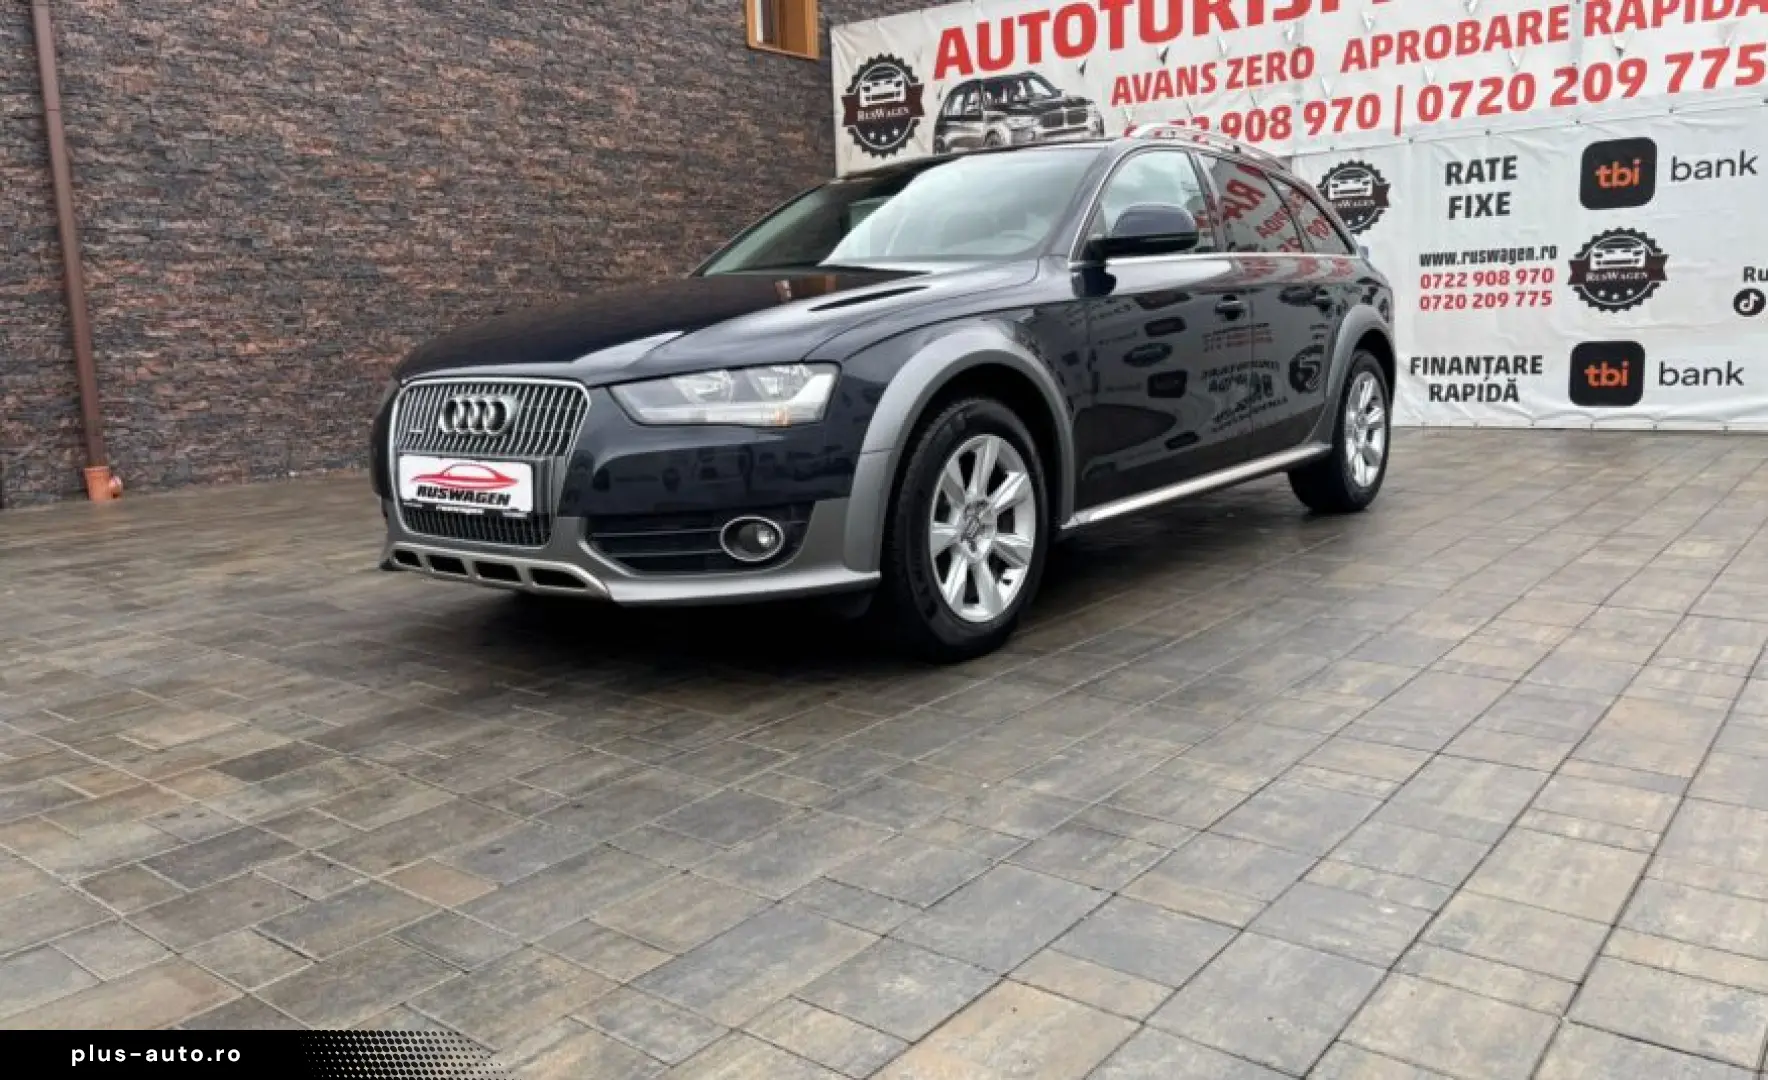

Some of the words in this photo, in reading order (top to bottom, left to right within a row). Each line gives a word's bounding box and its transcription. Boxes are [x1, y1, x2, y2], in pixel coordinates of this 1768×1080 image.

[1111, 62, 1217, 106] AVANS
[1226, 46, 1315, 89] ZERO
[1340, 5, 1569, 73] APROBARE
[1221, 104, 1293, 143] 908
[1303, 94, 1381, 136] 970
[1418, 73, 1536, 122] 0720
[1550, 58, 1648, 107] 209
[1665, 42, 1767, 93] 775
[1445, 156, 1518, 186] RATE
[1595, 158, 1642, 188] tbi
[1670, 150, 1759, 182] bank
[1448, 192, 1511, 220] FIXE
[1419, 245, 1559, 267] www.ruswagen.ro
[1420, 271, 1468, 290] 0722
[1472, 269, 1511, 287] 908
[1515, 267, 1554, 285] 970
[1419, 294, 1467, 311] 0720
[1472, 291, 1510, 309] 209
[1515, 290, 1553, 308] 775
[1584, 361, 1628, 387] tbi
[1658, 361, 1745, 387] bank
[1428, 378, 1520, 402] RAPIDĂ
[417, 485, 511, 506] RUSWAGEN
